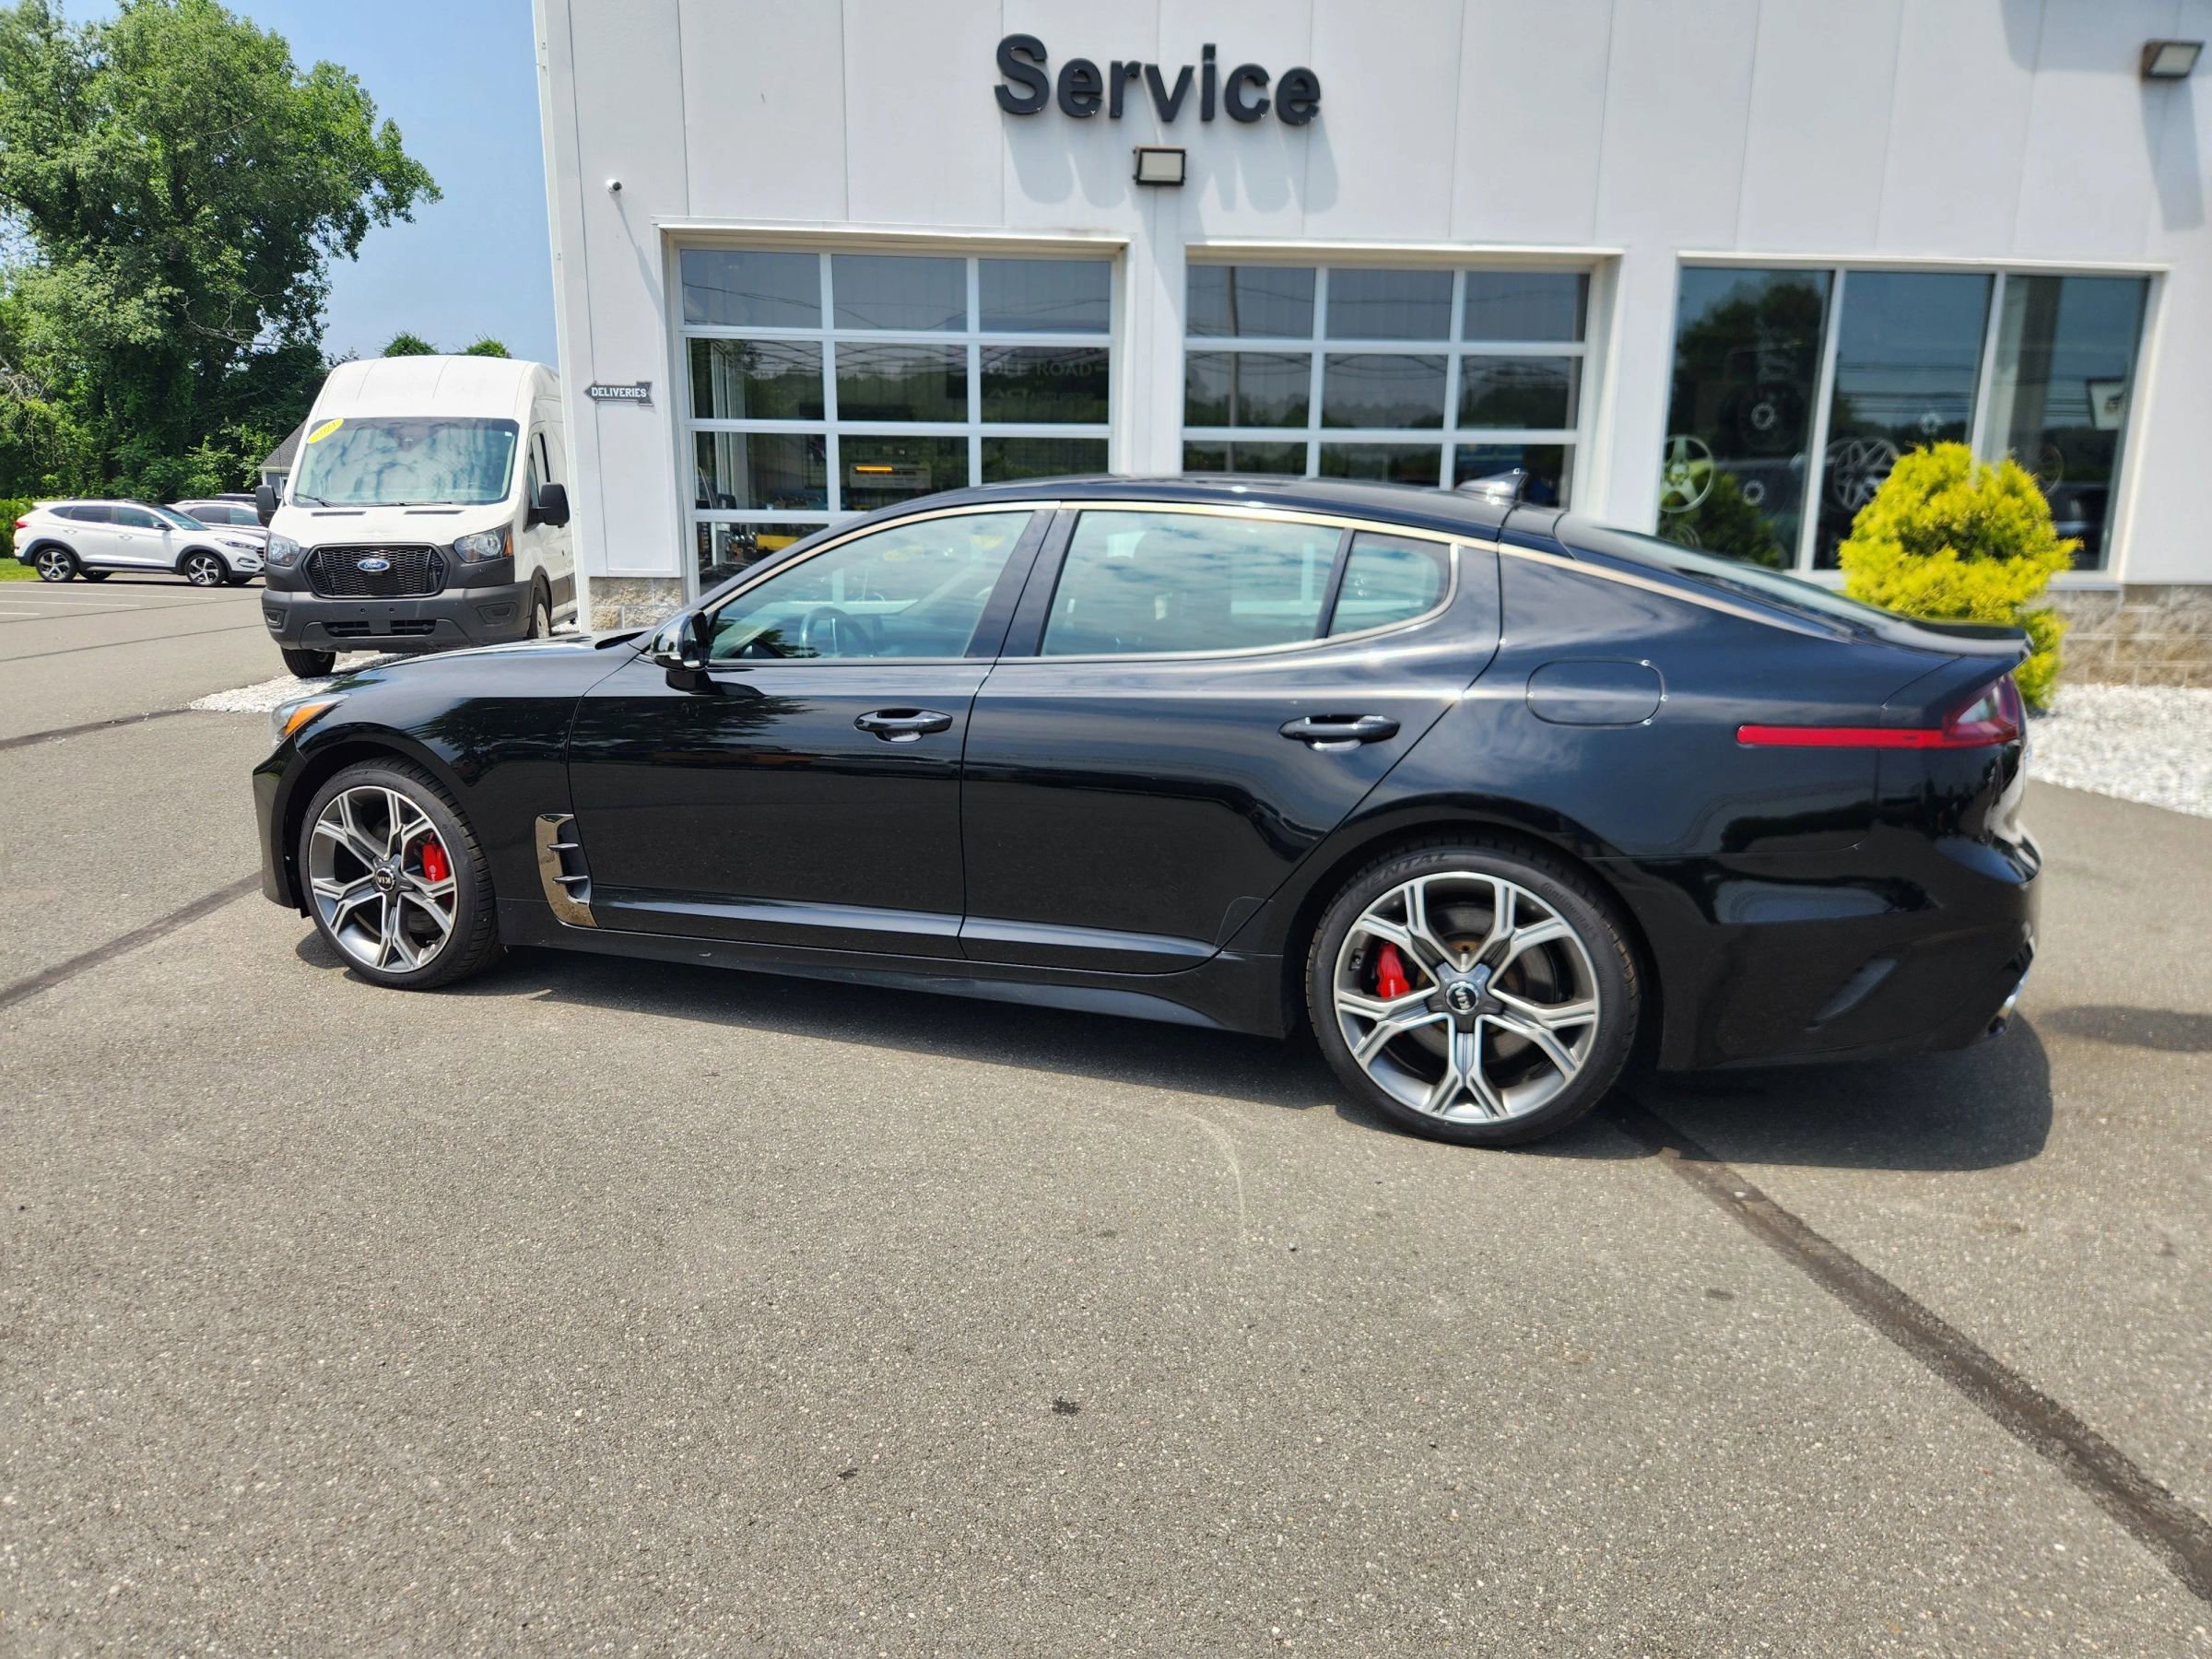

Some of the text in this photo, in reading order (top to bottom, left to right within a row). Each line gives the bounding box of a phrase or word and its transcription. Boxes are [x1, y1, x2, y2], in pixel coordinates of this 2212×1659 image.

[994, 33, 1321, 126] Service
[1037, 361, 1092, 376] ROAD
[591, 386, 647, 398] DELIVERIES
